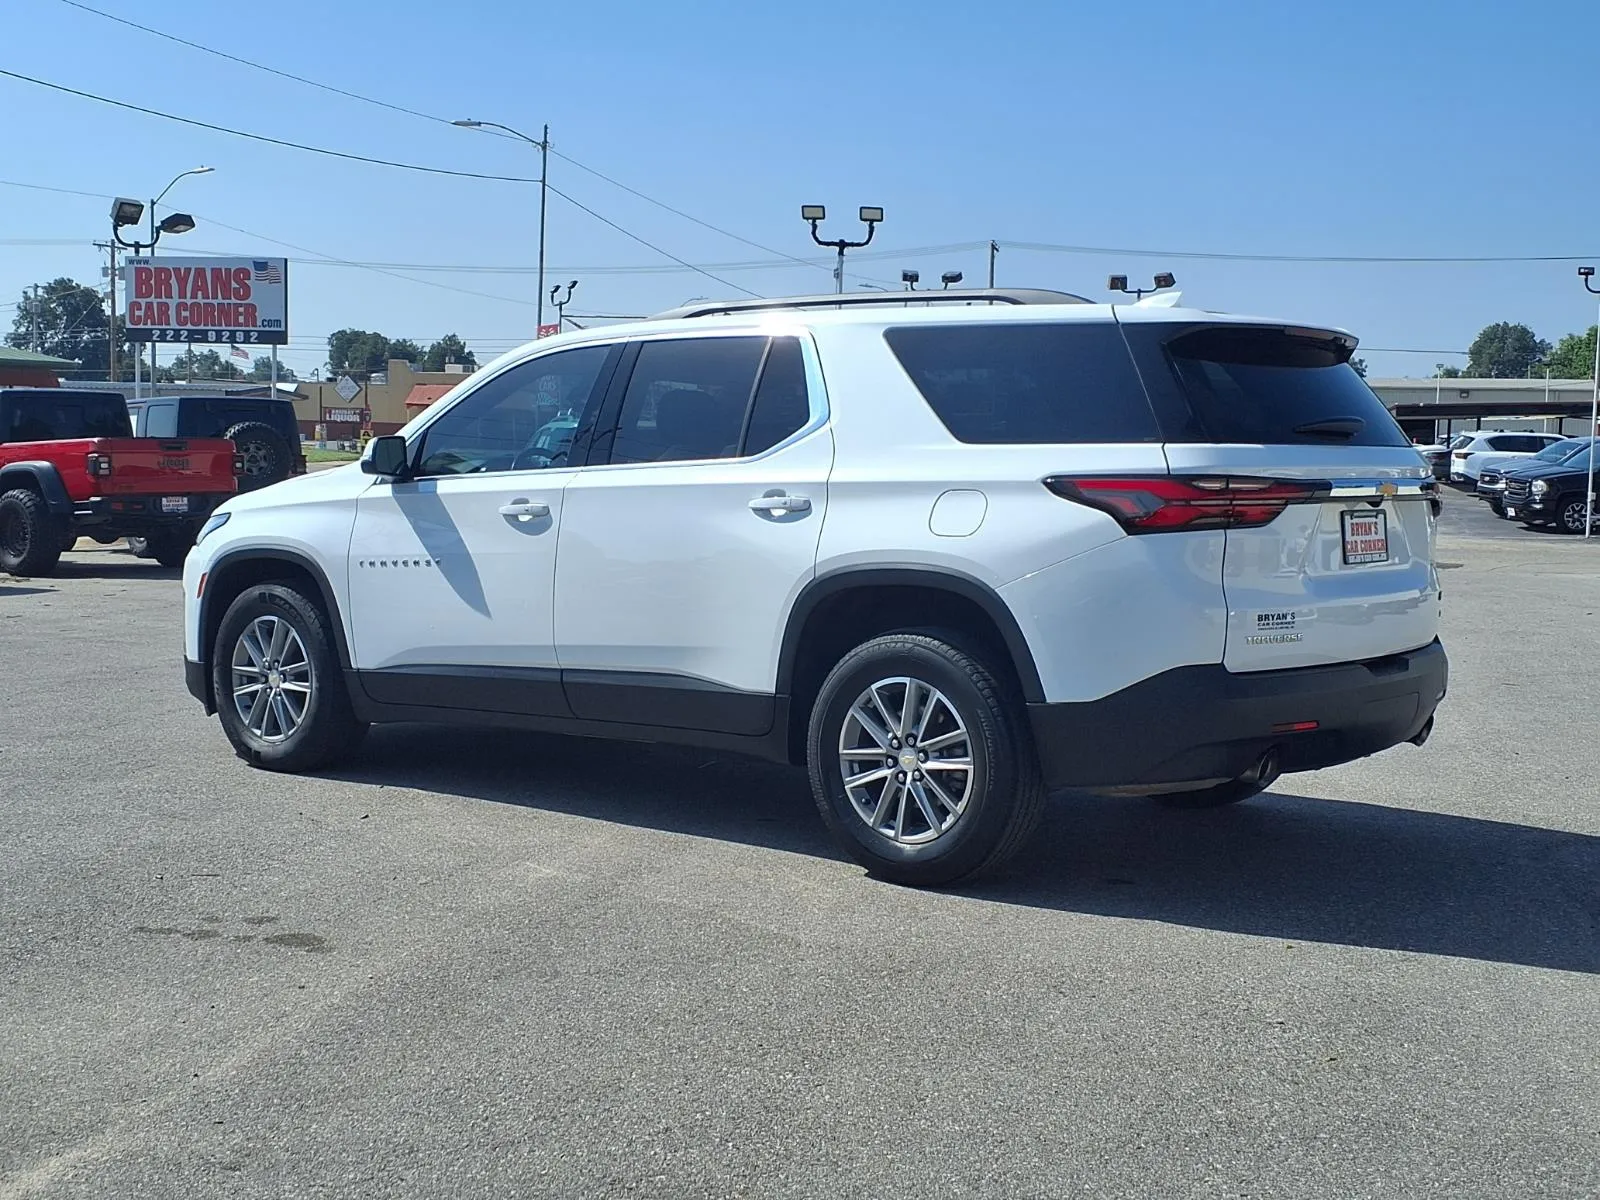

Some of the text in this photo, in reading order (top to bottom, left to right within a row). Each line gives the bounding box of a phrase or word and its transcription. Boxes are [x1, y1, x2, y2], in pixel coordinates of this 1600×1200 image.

[134, 266, 251, 301] BRYANS
[128, 300, 171, 326] CAR
[152, 329, 259, 343] 222-9292
[326, 413, 360, 423] LIQUOR
[1350, 521, 1379, 537] BRYAN'S
[1345, 539, 1386, 554] CAR CORNER
[1257, 612, 1296, 622] BRYAN'S
